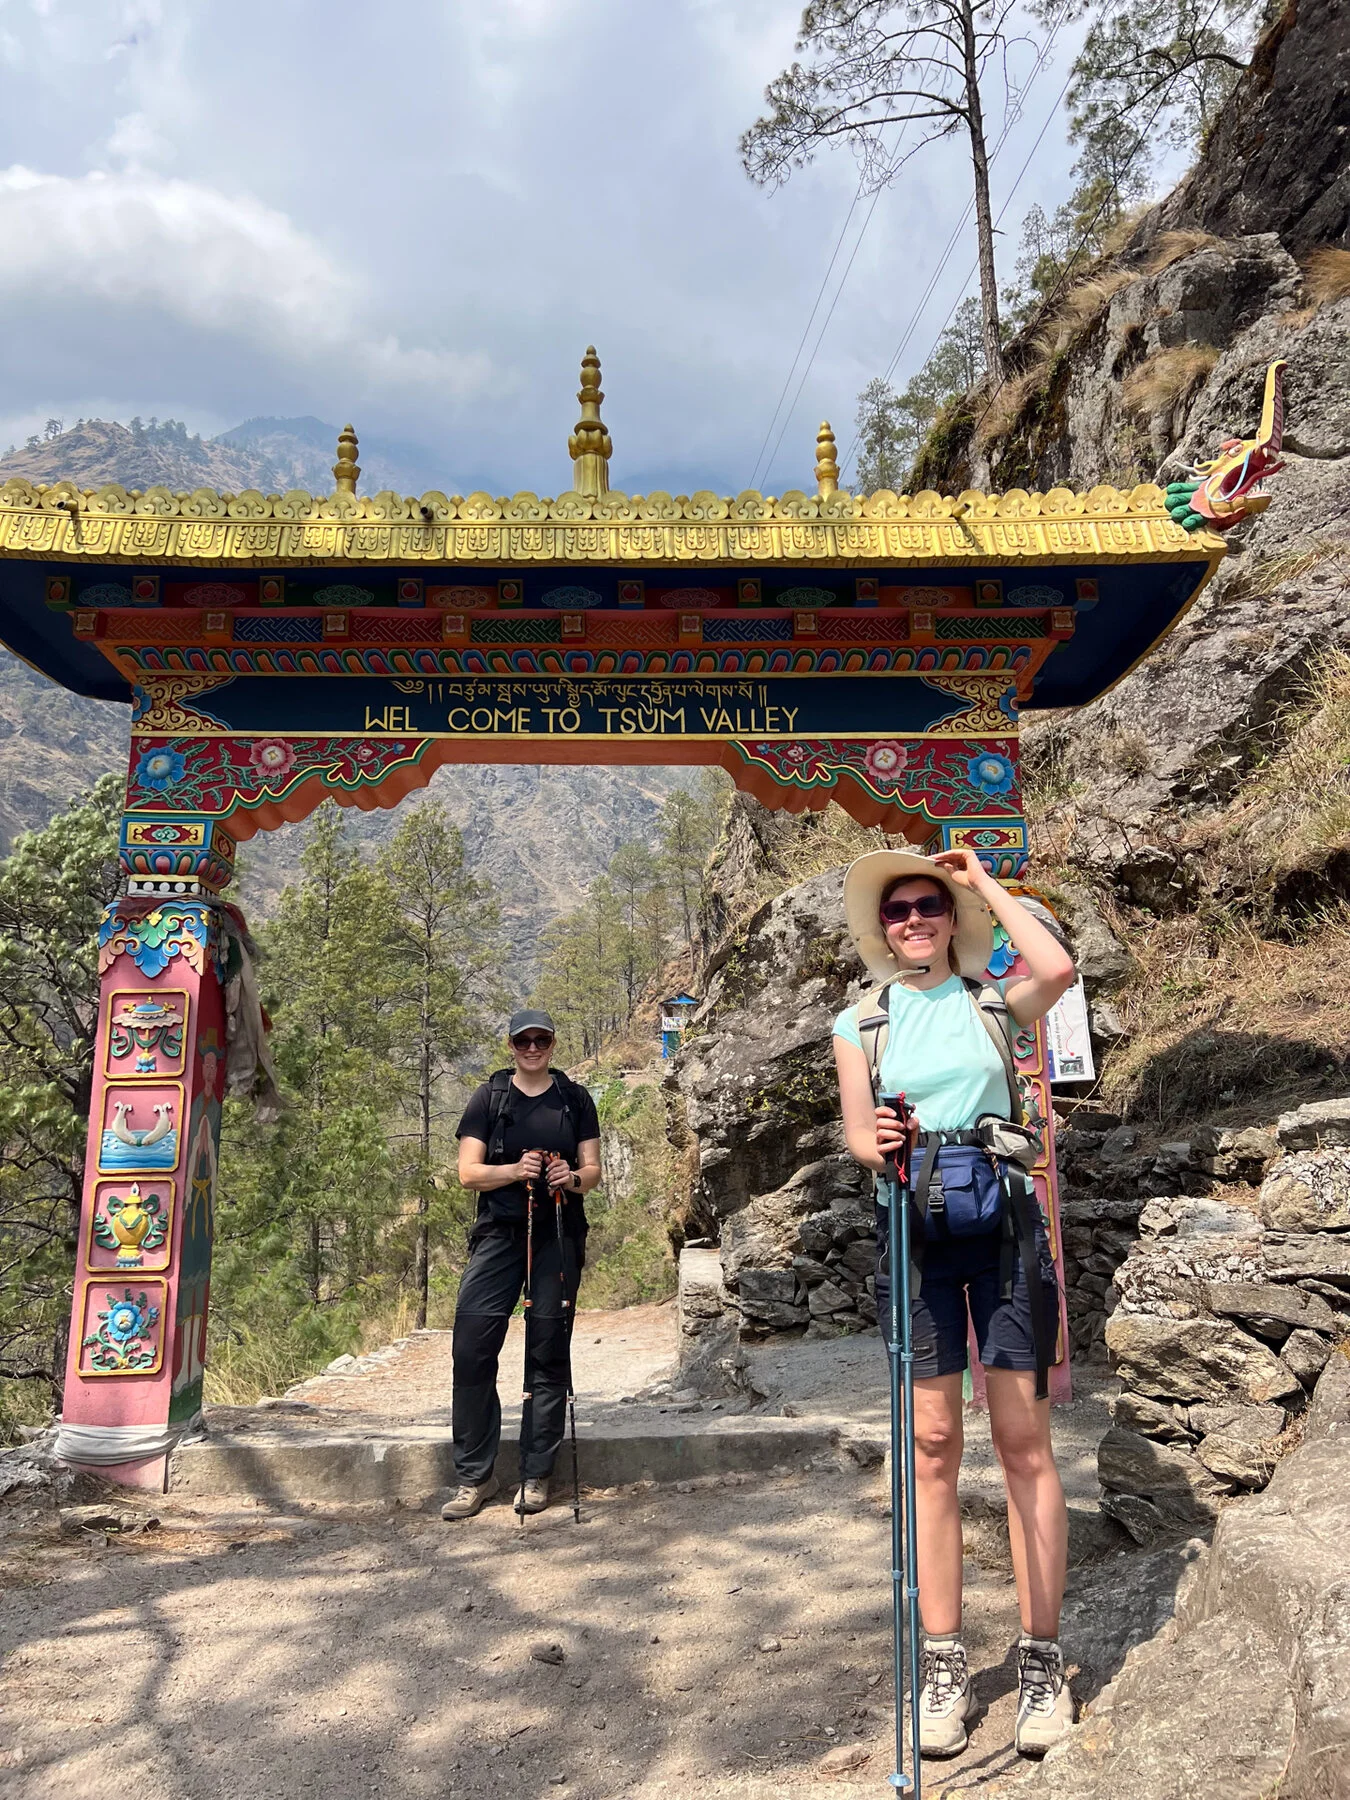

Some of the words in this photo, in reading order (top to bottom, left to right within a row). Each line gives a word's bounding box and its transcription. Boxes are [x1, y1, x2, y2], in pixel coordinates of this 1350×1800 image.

[365, 706, 418, 731] WEL
[448, 707, 531, 733] COME
[541, 707, 581, 733] TO
[598, 707, 686, 734] TSUM
[699, 706, 799, 733] VALLEY
